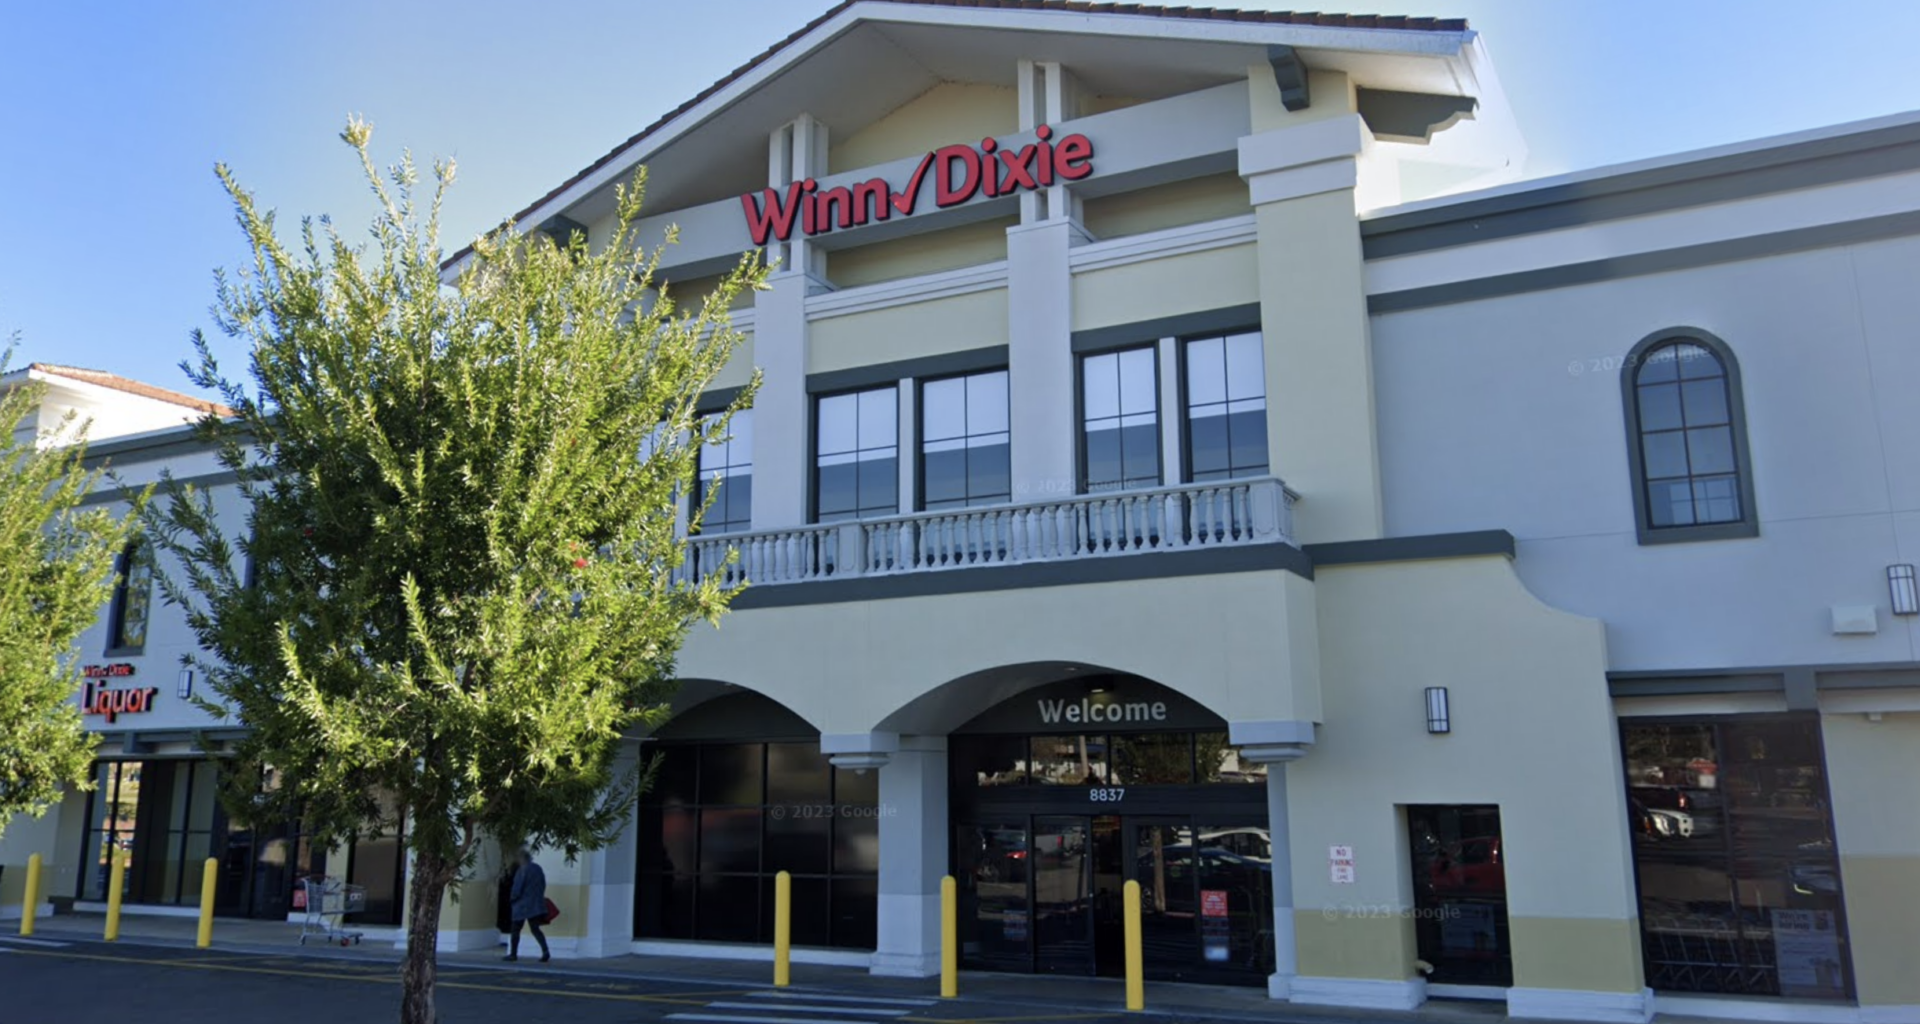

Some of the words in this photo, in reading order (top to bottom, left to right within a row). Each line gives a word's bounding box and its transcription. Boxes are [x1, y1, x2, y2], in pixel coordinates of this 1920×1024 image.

[740, 177, 890, 245] Winn
[935, 124, 1094, 208] Dixie
[81, 679, 158, 723] Liquor
[1038, 698, 1166, 723] Welcome
[1090, 788, 1125, 801] 8837
[1336, 848, 1347, 857] NO
